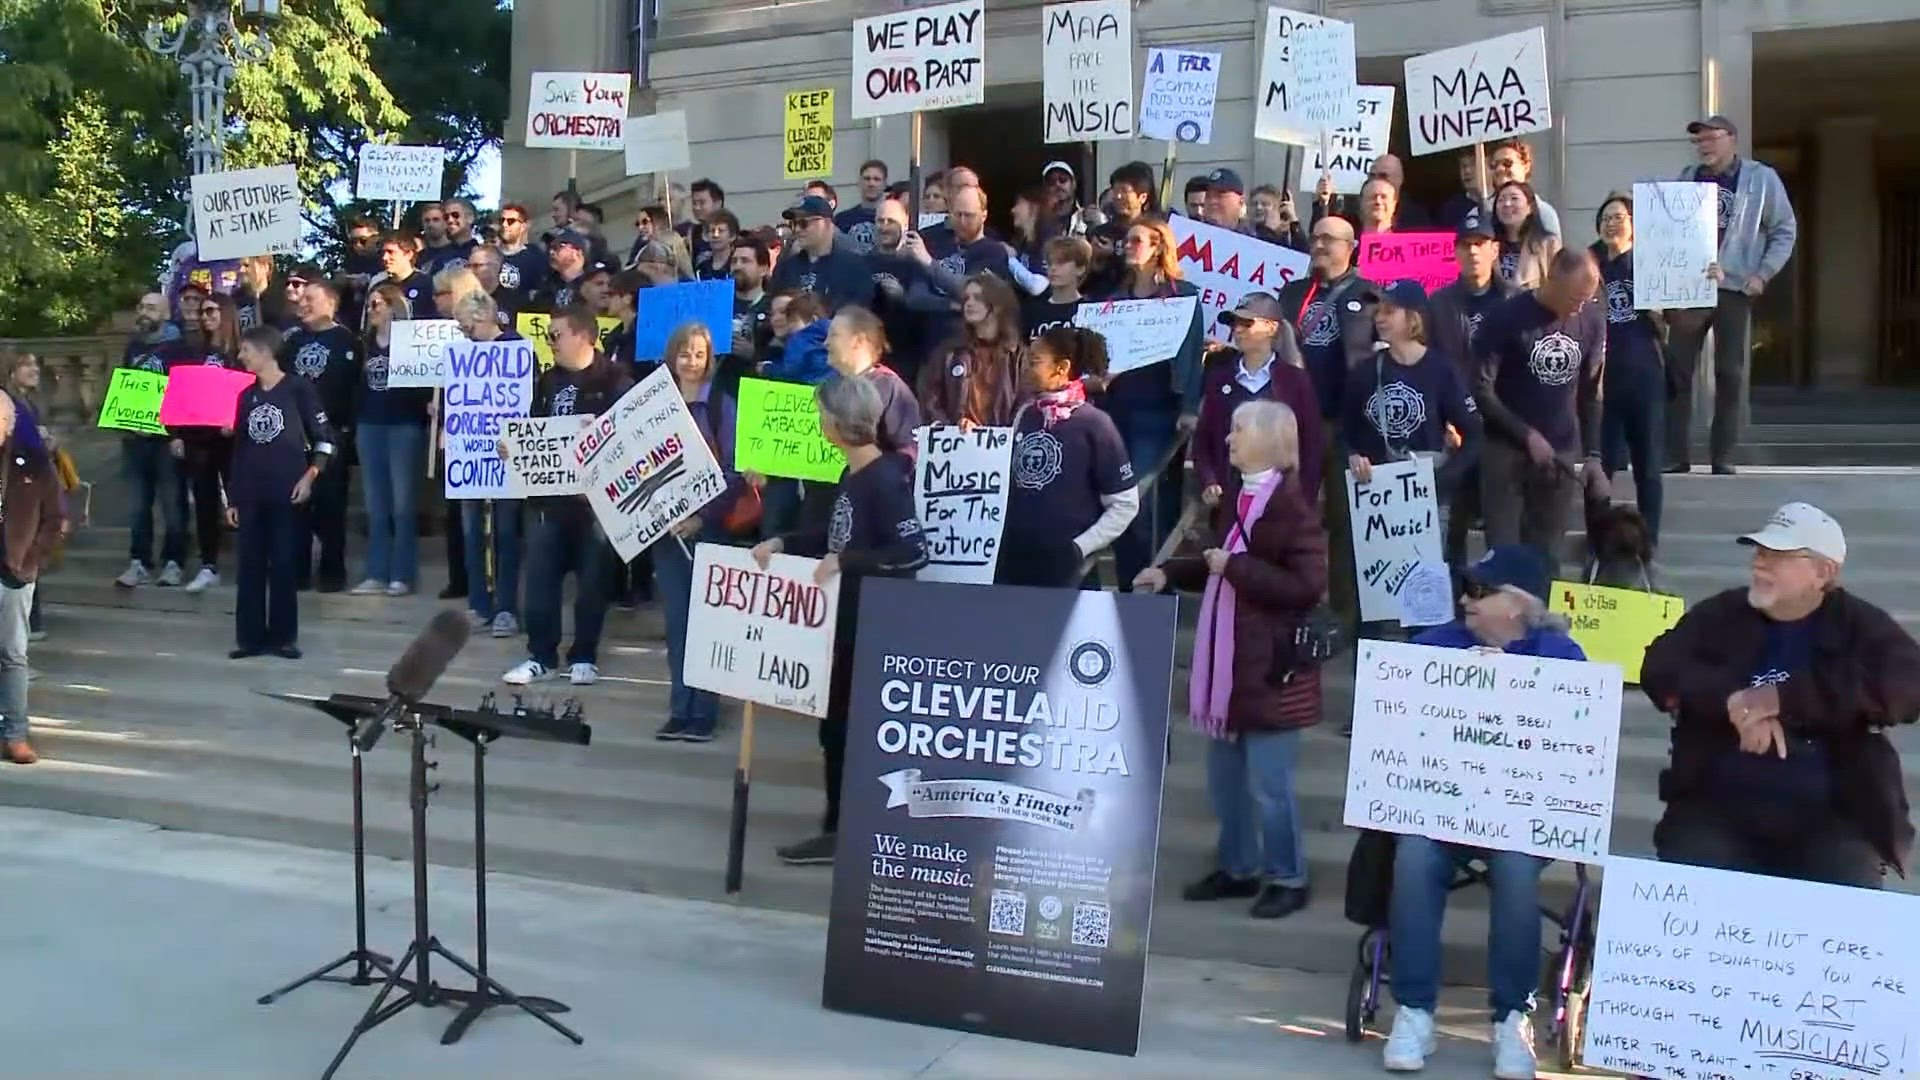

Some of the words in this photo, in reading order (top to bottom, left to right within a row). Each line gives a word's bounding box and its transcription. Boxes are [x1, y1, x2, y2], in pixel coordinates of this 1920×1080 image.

[867, 20, 908, 52] WE
[915, 10, 980, 46] PLAY
[1047, 11, 1118, 44] MAA
[1150, 52, 1163, 73] A
[867, 67, 920, 100] OUR
[925, 58, 980, 90] PART
[1434, 67, 1525, 110] MAA
[789, 92, 829, 110] KEEP
[532, 112, 620, 138] ORCHESTRA
[800, 112, 820, 125] THE
[1046, 102, 1129, 139] MUSIC
[1420, 100, 1536, 145] UNFAIR
[787, 154, 827, 172] CLASS!
[792, 142, 825, 157] WORLD
[203, 189, 232, 213] OUR
[234, 182, 294, 204] FUTURE
[209, 222, 225, 240] AT
[229, 208, 281, 235] STAKE
[1177, 234, 1294, 292] MAA'S
[1368, 242, 1405, 264] FOR
[414, 324, 462, 340] KEEP
[390, 362, 444, 376] WORLD-C
[449, 346, 531, 378] WORLD
[120, 373, 150, 391] THIS
[447, 382, 520, 408] CLASS
[762, 391, 818, 412] CLEVEL
[508, 422, 546, 438] PLAY
[574, 411, 616, 465] LEGACY
[623, 379, 668, 419] ORCHESTRAS
[633, 429, 644, 440] IN
[648, 402, 680, 428] THEIR
[762, 416, 823, 438] AMBASSA
[463, 439, 494, 452] WORLD
[518, 436, 574, 452] TOGET
[749, 438, 762, 450] TO
[773, 440, 802, 456] THE
[928, 428, 964, 453] For
[972, 428, 1007, 447] The
[448, 457, 506, 488] CONTRA
[513, 454, 561, 471] STAND
[605, 432, 684, 502] MUSICIANS!
[522, 471, 576, 486] TOGETH
[693, 474, 718, 502] ???
[1354, 479, 1392, 509] For
[1396, 472, 1428, 501] The
[926, 500, 957, 522] For
[964, 497, 1000, 522] The
[705, 564, 764, 614] BEST
[763, 575, 827, 628] BAND
[711, 641, 737, 672] THE
[758, 652, 809, 689] LAND
[883, 655, 975, 680] PROTECT
[982, 663, 1039, 685] YOUR
[1378, 661, 1412, 682] STOP
[1424, 661, 1495, 690] CHOPIN
[1510, 678, 1536, 689] OUR
[881, 679, 1121, 731] CLEVELAND
[1375, 700, 1406, 714] THIS
[1421, 704, 1467, 719] COULD
[1517, 716, 1552, 729] BEEN
[876, 720, 1130, 777] ORCHESTRA
[1453, 726, 1514, 748] HANDEL
[1371, 749, 1407, 766] MAA
[1422, 757, 1449, 771] HAS
[1461, 760, 1486, 774] THE
[1560, 773, 1576, 784] TO
[1387, 772, 1462, 797] COMPOSE
[1505, 789, 1535, 802] FAIR
[1369, 800, 1425, 826] BRING
[1437, 815, 1458, 830] THE
[1464, 817, 1510, 840] MUSIC
[1529, 818, 1602, 856] BACH!
[875, 834, 906, 855] We
[912, 842, 967, 863] make
[872, 858, 905, 879] the
[910, 866, 974, 887] music.
[1664, 912, 1698, 937] YOU
[1715, 922, 1755, 944] ARE
[1767, 932, 1808, 948] NOT
[1822, 939, 1883, 960] CARE-
[1608, 940, 1662, 958] TAKERS
[1673, 946, 1692, 960] OF
[1709, 952, 1795, 975] DONATIONS
[1823, 966, 1851, 984] YOU
[1872, 977, 1906, 995] ARE
[1601, 971, 1696, 994] CARETAKERS
[1712, 985, 1732, 1000] OF
[1749, 991, 1783, 1007] THE
[1796, 991, 1867, 1020] ART
[1596, 999, 1674, 1021] THROUGH
[1688, 1012, 1723, 1030] THE
[1740, 1018, 1908, 1073] MUSICIANS!
[1593, 1032, 1640, 1051] WATER
[1651, 1042, 1679, 1058] THE
[1691, 1049, 1738, 1066] PLANT
[1761, 1062, 1776, 1072] IT
[1603, 1056, 1656, 1072] WITHHOLD
[1664, 1066, 1687, 1078] THE
